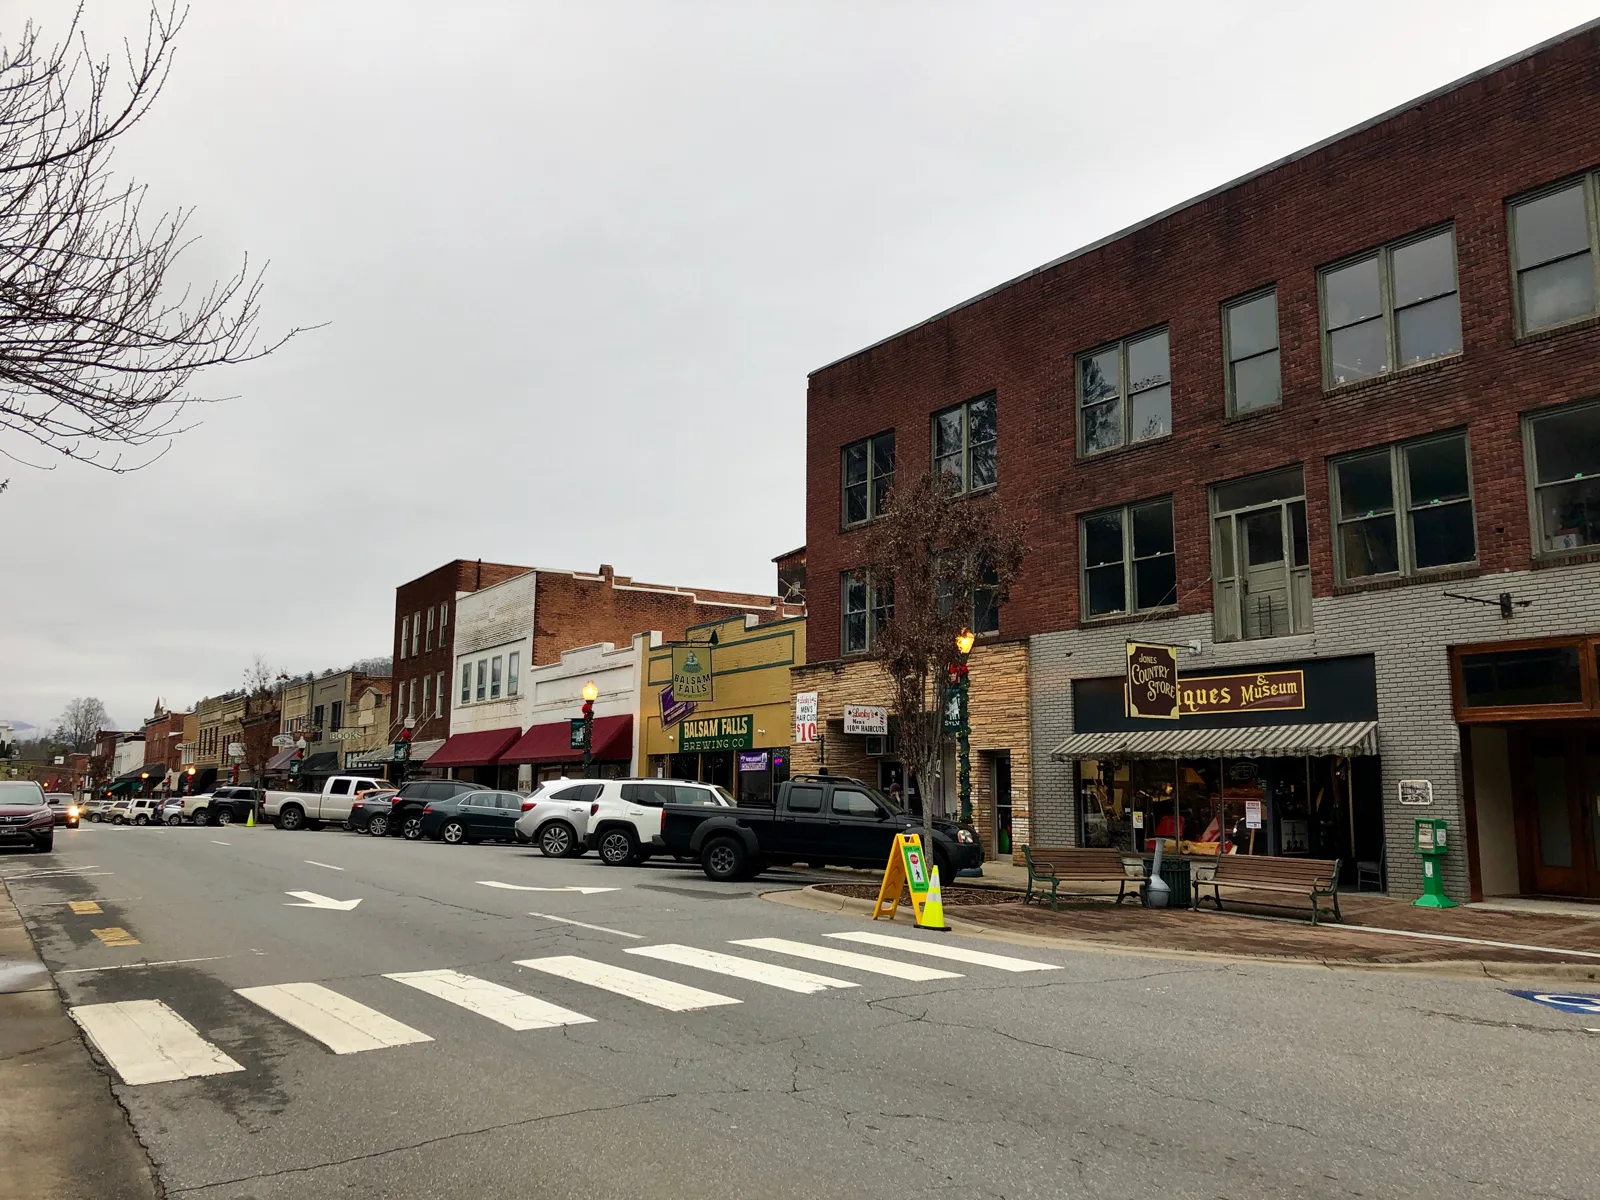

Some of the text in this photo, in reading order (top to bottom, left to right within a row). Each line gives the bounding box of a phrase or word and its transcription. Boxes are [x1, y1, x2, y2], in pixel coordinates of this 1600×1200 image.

[1139, 653, 1157, 664] JONES
[674, 674, 711, 685] BALSAM
[1131, 664, 1170, 685] COUNTRY
[678, 684, 707, 693] FALLS
[1147, 680, 1176, 701] STORE
[1178, 673, 1298, 711] iques & Museum
[801, 706, 813, 714] MEN'S
[851, 708, 875, 720] Lucky's
[683, 716, 748, 739] BALSAM FALLS
[860, 725, 885, 733] HAIRCUTS
[329, 731, 362, 740] BOOKS
[683, 738, 744, 751] BREWING CO
